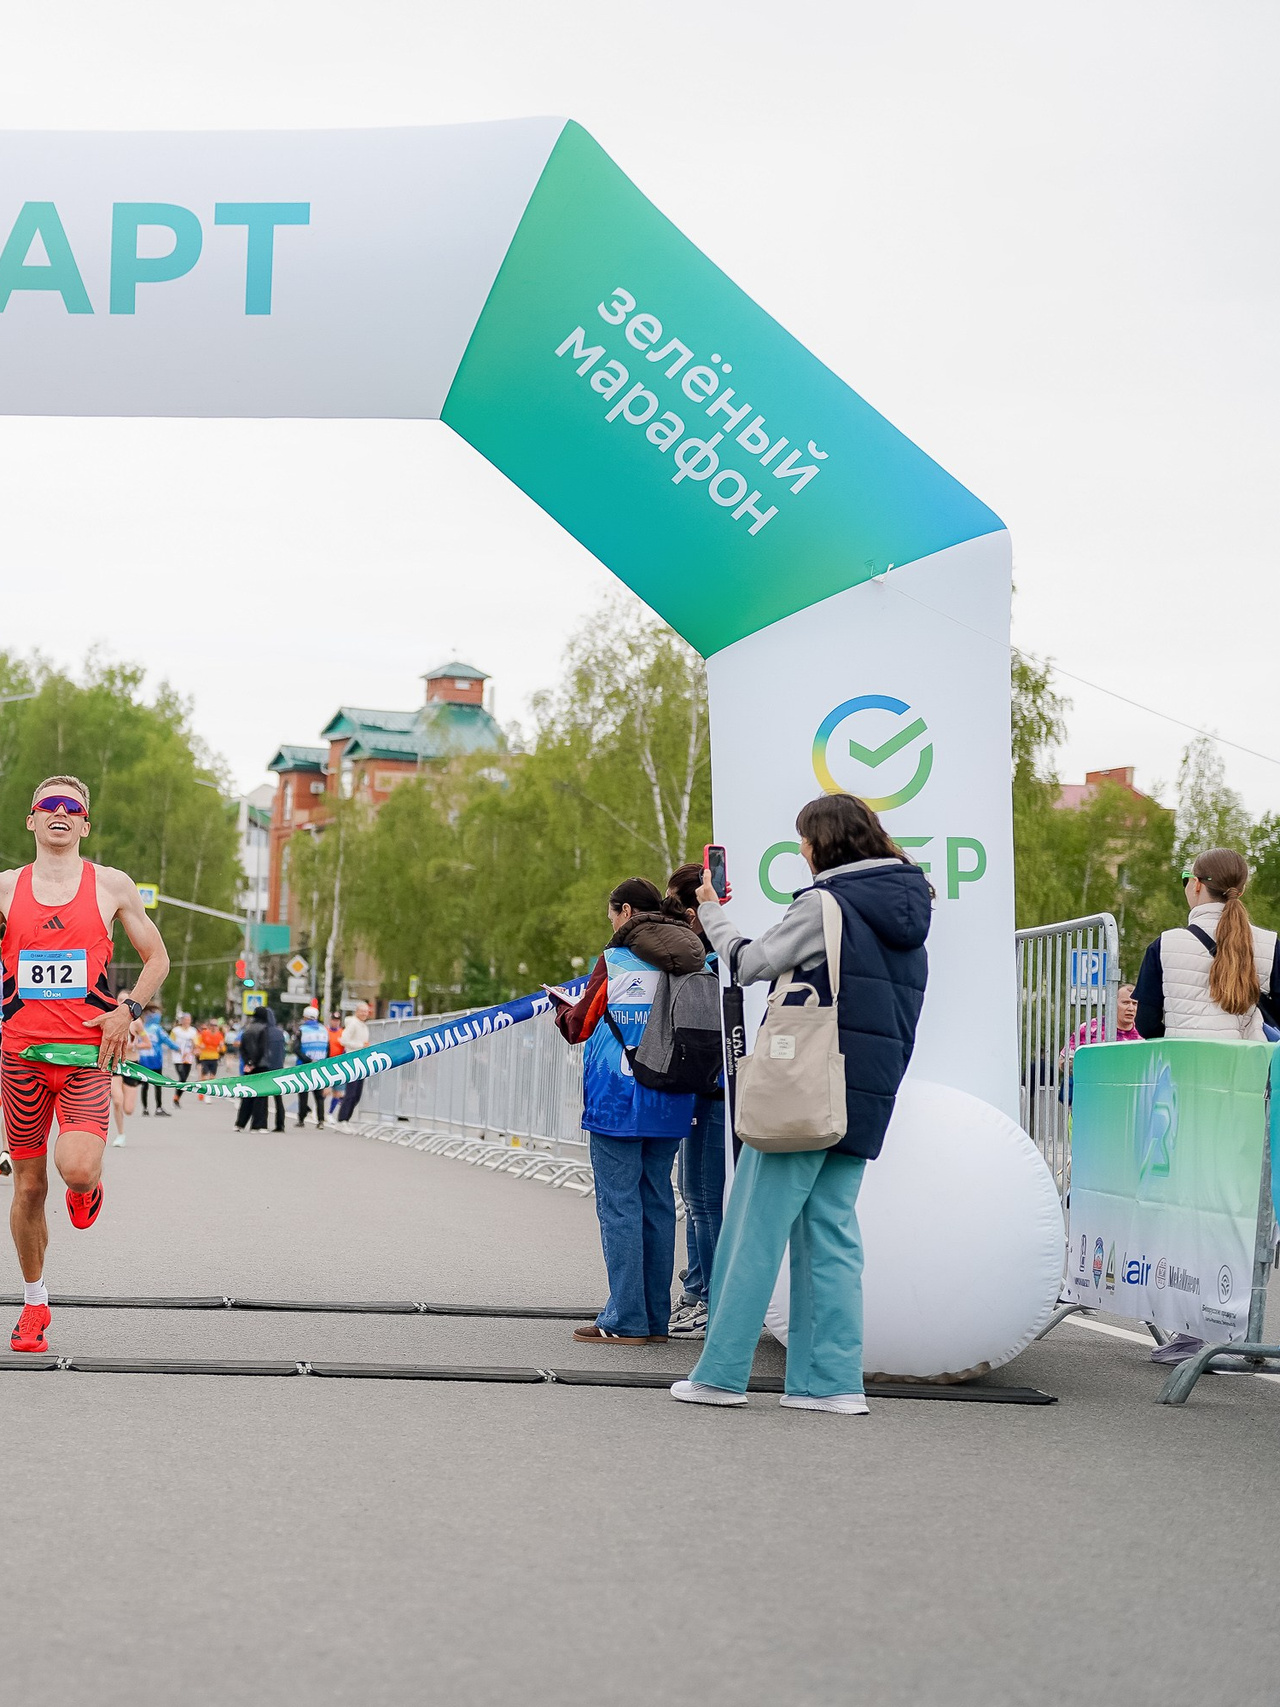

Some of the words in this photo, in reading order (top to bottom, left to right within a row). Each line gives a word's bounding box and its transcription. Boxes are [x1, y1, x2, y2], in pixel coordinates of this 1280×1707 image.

[597, 287, 829, 495] зелёный
[554, 326, 779, 536] марафон
[32, 965, 72, 983] 812
[410, 1010, 514, 1060] ФИНИШ
[272, 1050, 392, 1095] ФИНИШ
